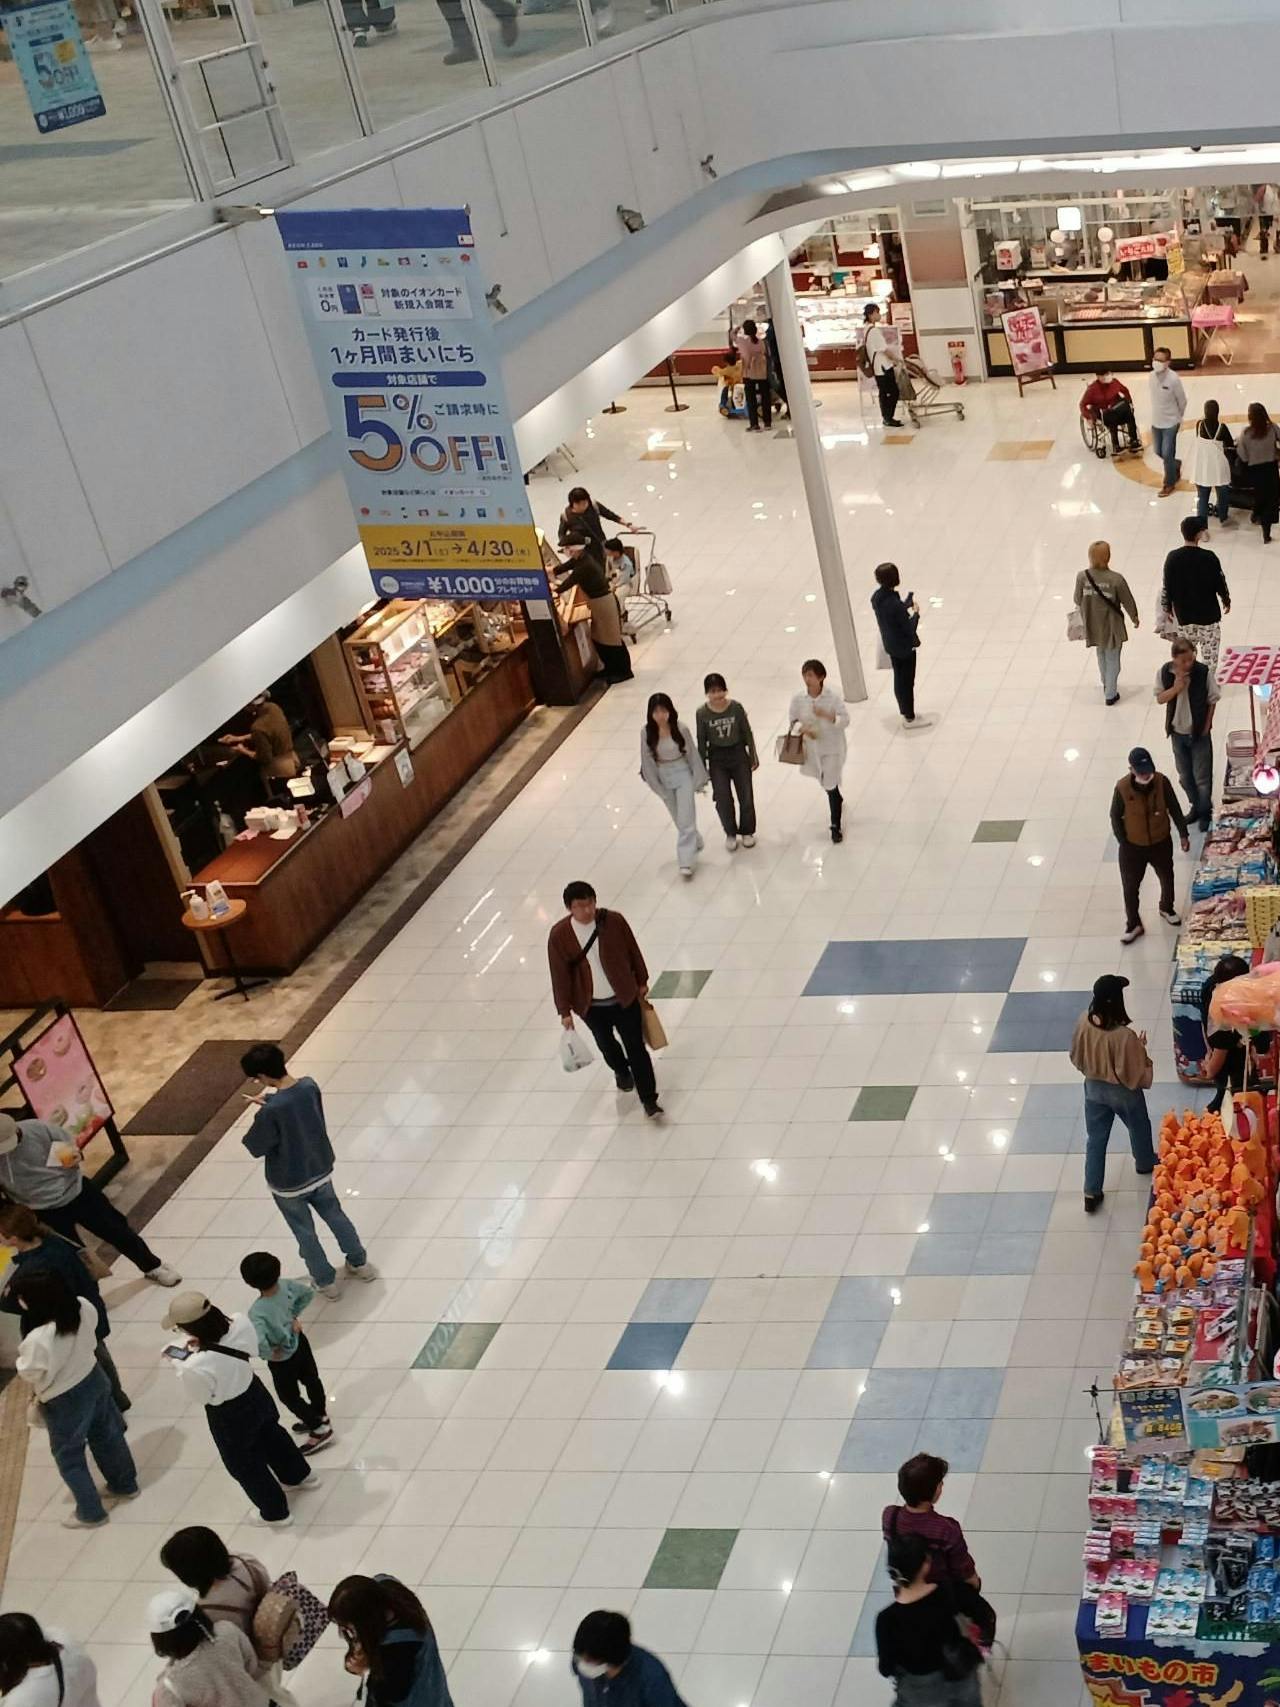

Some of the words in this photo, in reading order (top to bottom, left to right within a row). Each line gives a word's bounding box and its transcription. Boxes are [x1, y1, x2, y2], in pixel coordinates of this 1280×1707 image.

[351, 326, 441, 342] カード発行後
[330, 344, 475, 365] 1ヶ月間まいにち
[409, 434, 509, 474] OFF!
[467, 540, 514, 557] 4/30
[715, 723, 732, 739] 17
